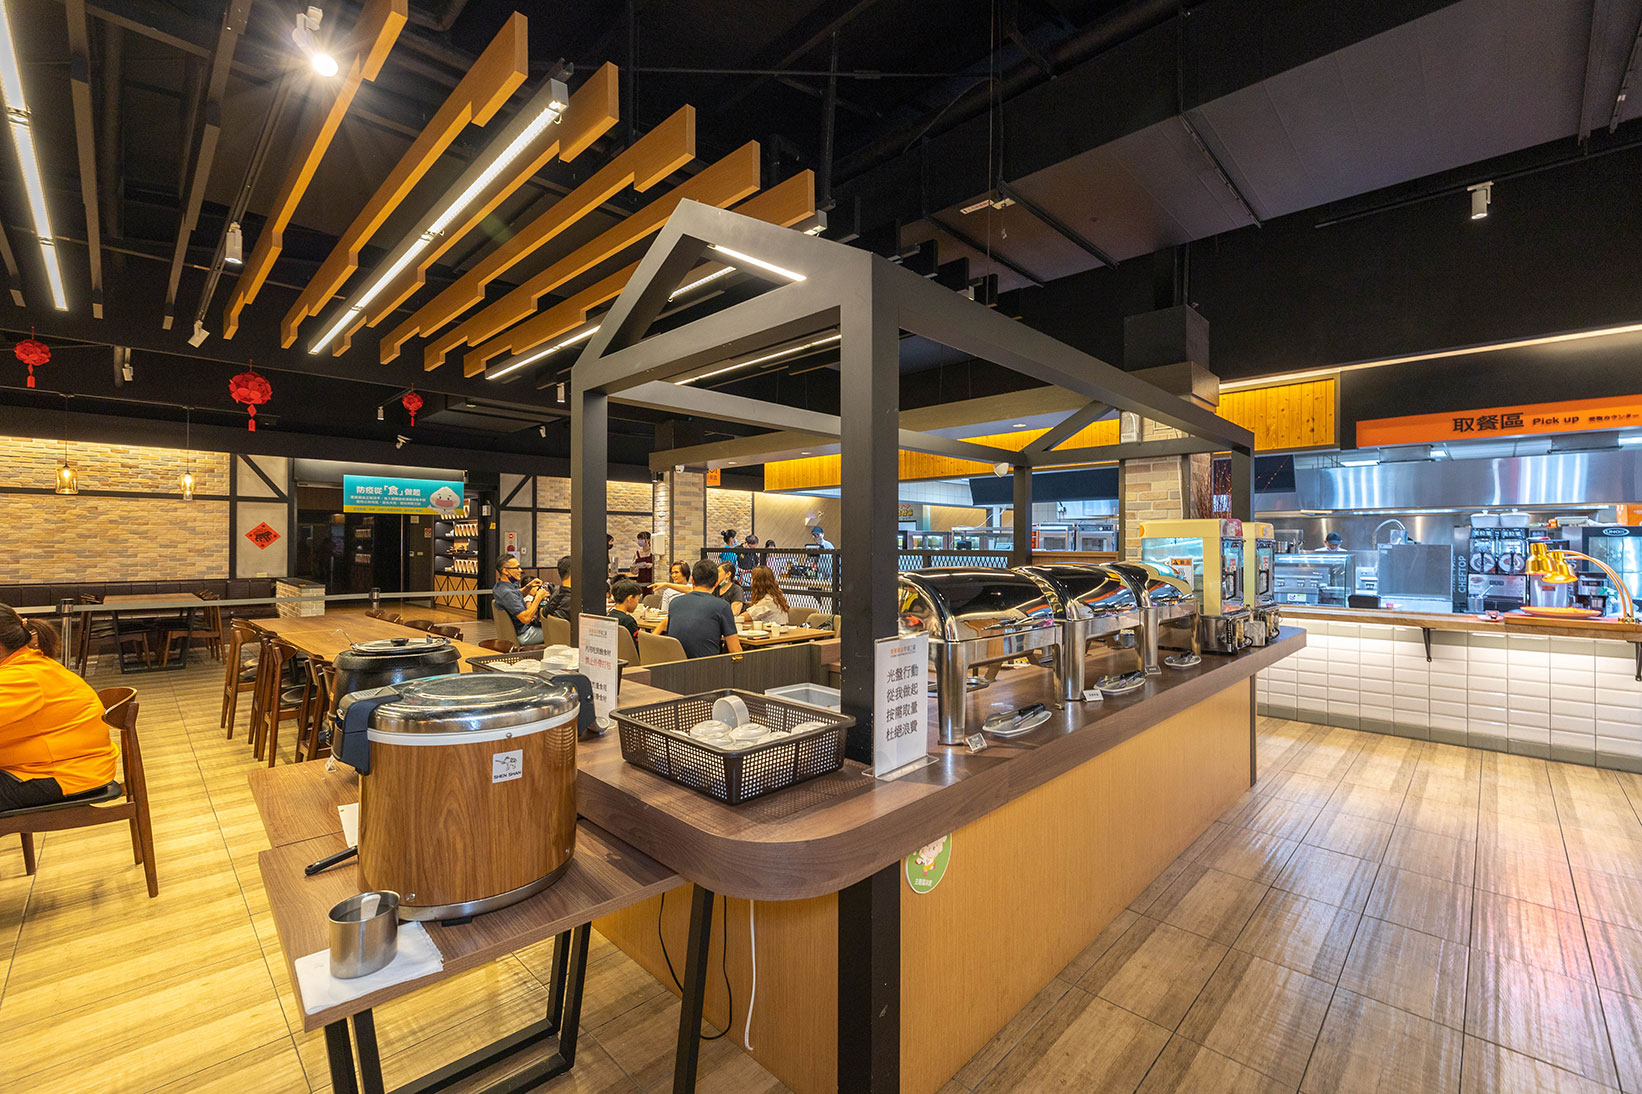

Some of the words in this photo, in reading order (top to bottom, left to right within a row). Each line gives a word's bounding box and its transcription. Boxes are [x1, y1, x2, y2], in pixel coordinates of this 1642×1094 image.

[1452, 412, 1525, 432] 取餐區
[1532, 416, 1560, 426] Pick
[1564, 416, 1579, 424] up
[1458, 555, 1467, 593] CHEFTOP
[887, 664, 919, 684] 光盤行動
[886, 682, 919, 703] 從我做起
[886, 701, 918, 723] 按需取量
[886, 719, 918, 742] 杜絕浪費
